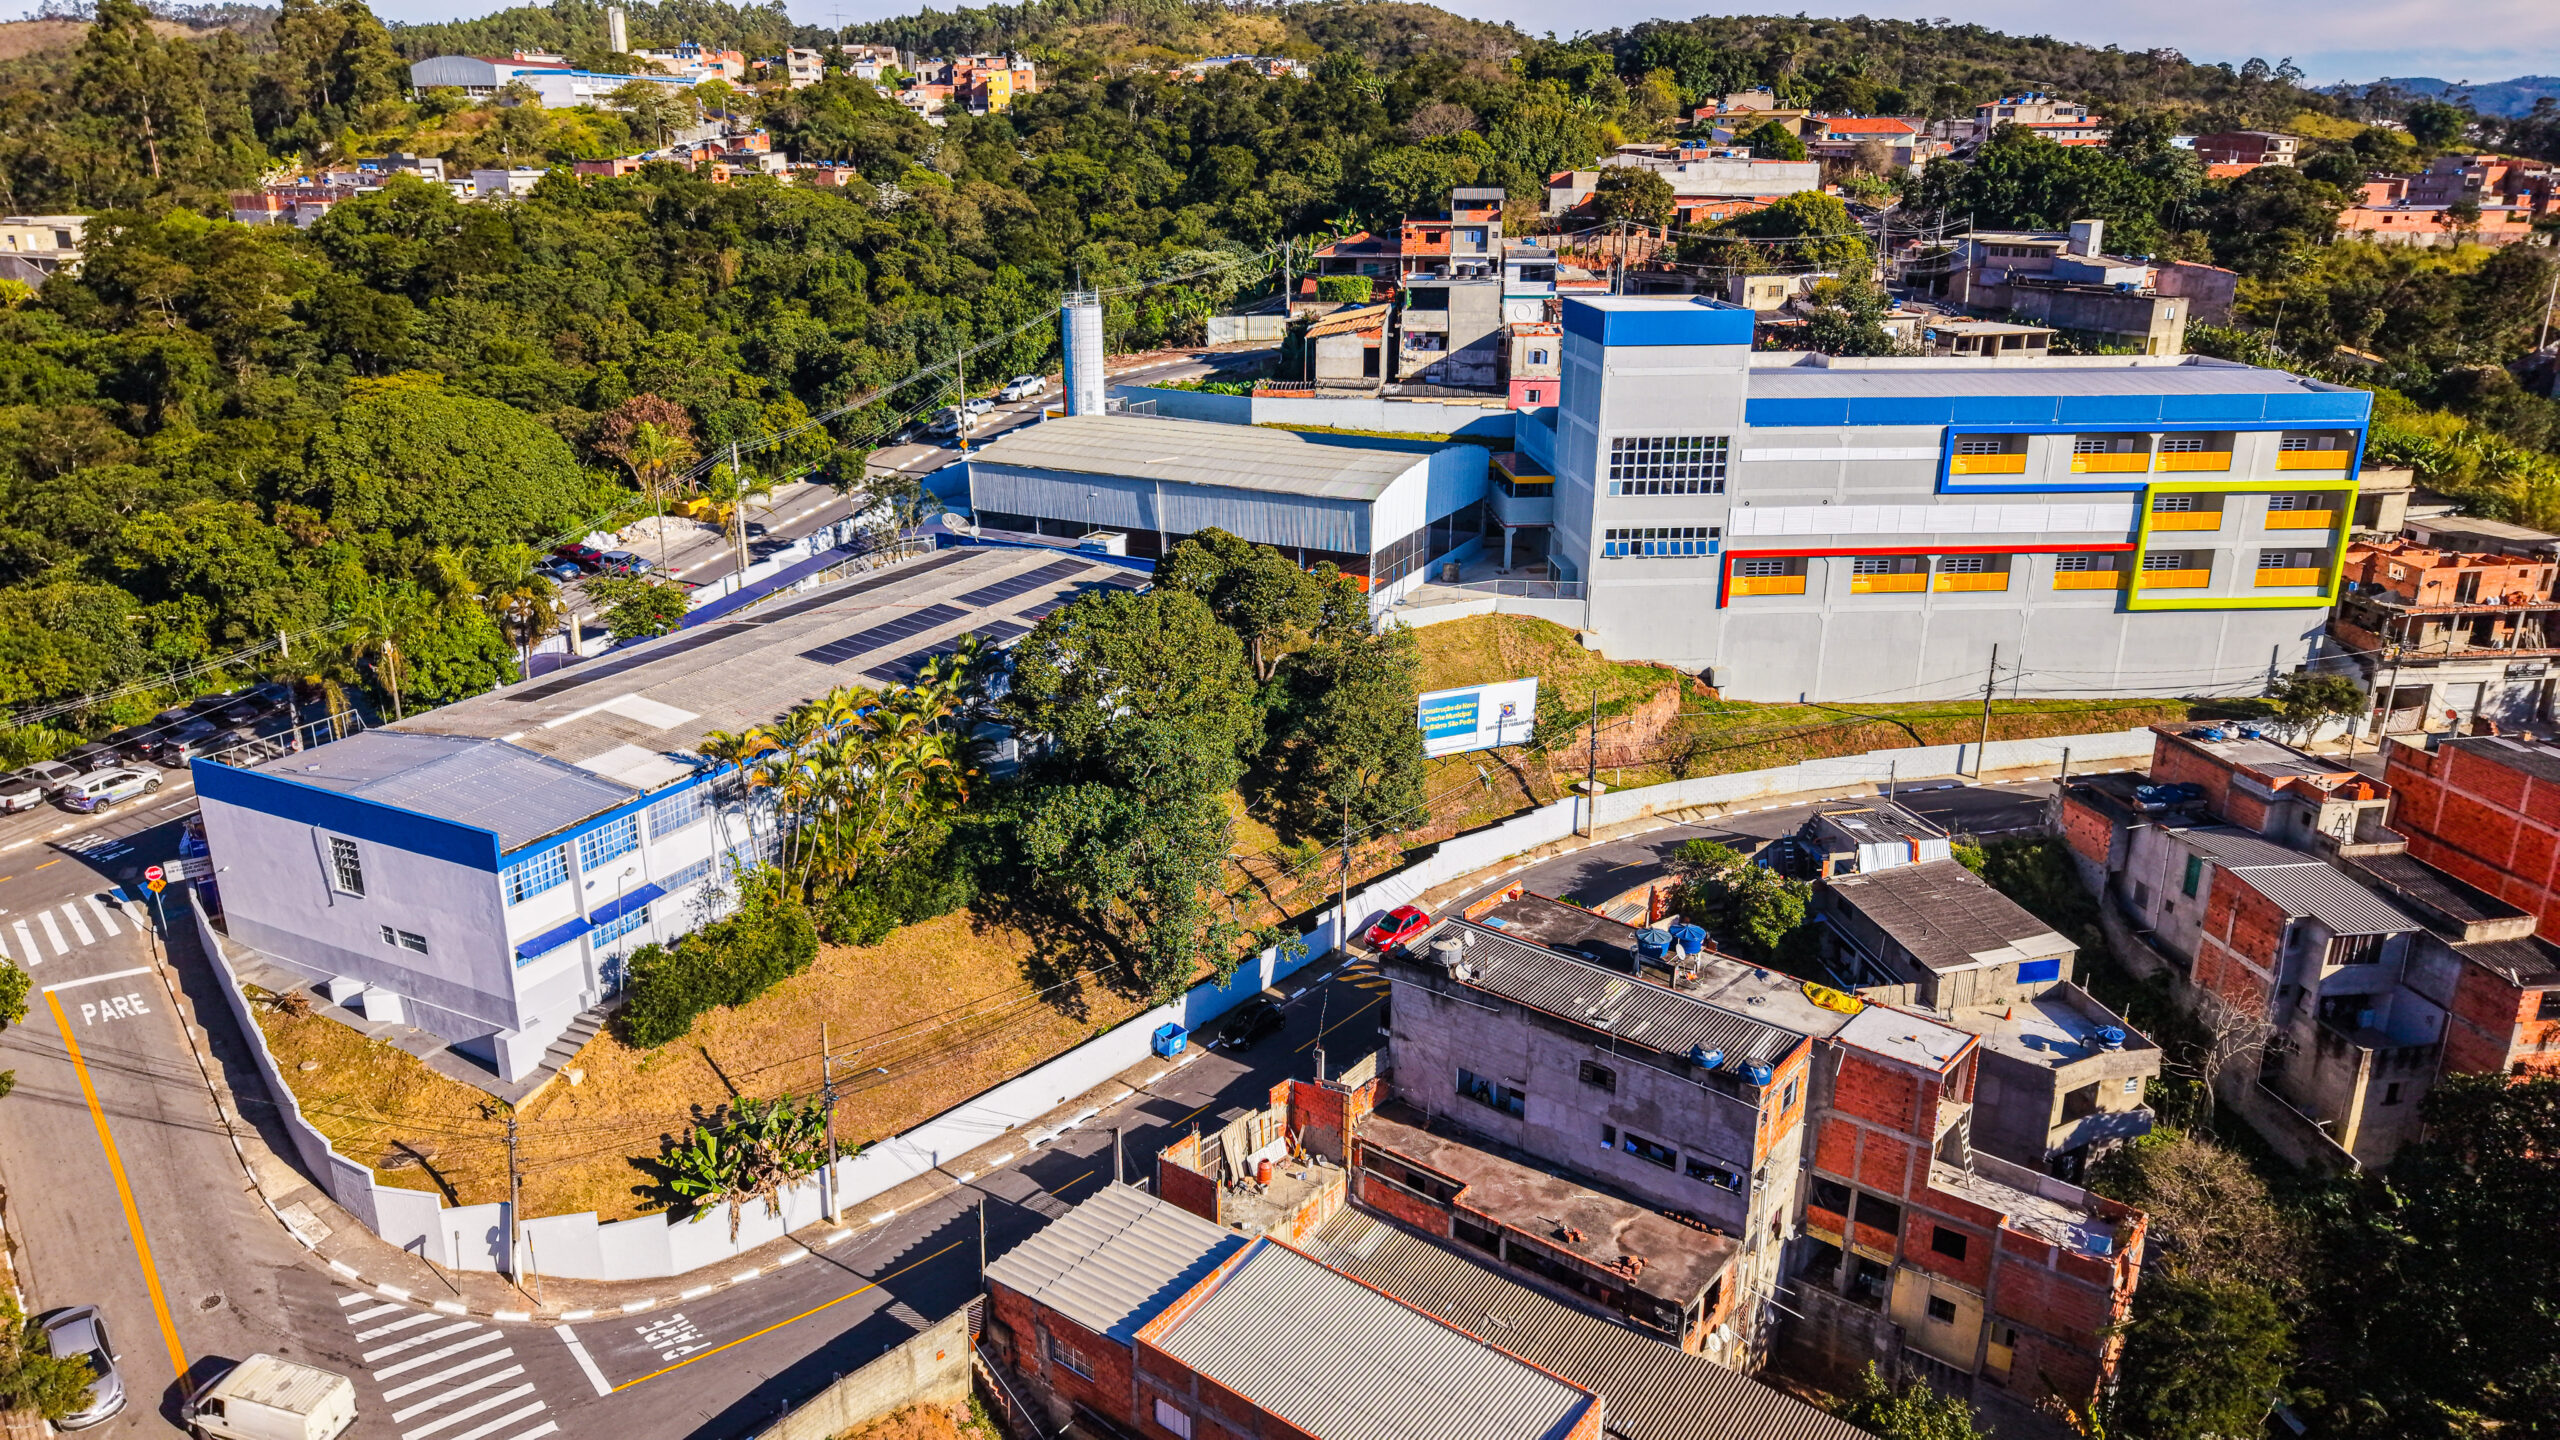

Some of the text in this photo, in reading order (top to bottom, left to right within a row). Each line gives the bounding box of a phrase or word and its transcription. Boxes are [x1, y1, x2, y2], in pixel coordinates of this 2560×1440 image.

[1425, 710, 1472, 723] Creche Municipal
[81, 993, 151, 1026] PARE
[634, 1312, 713, 1362] PARE
